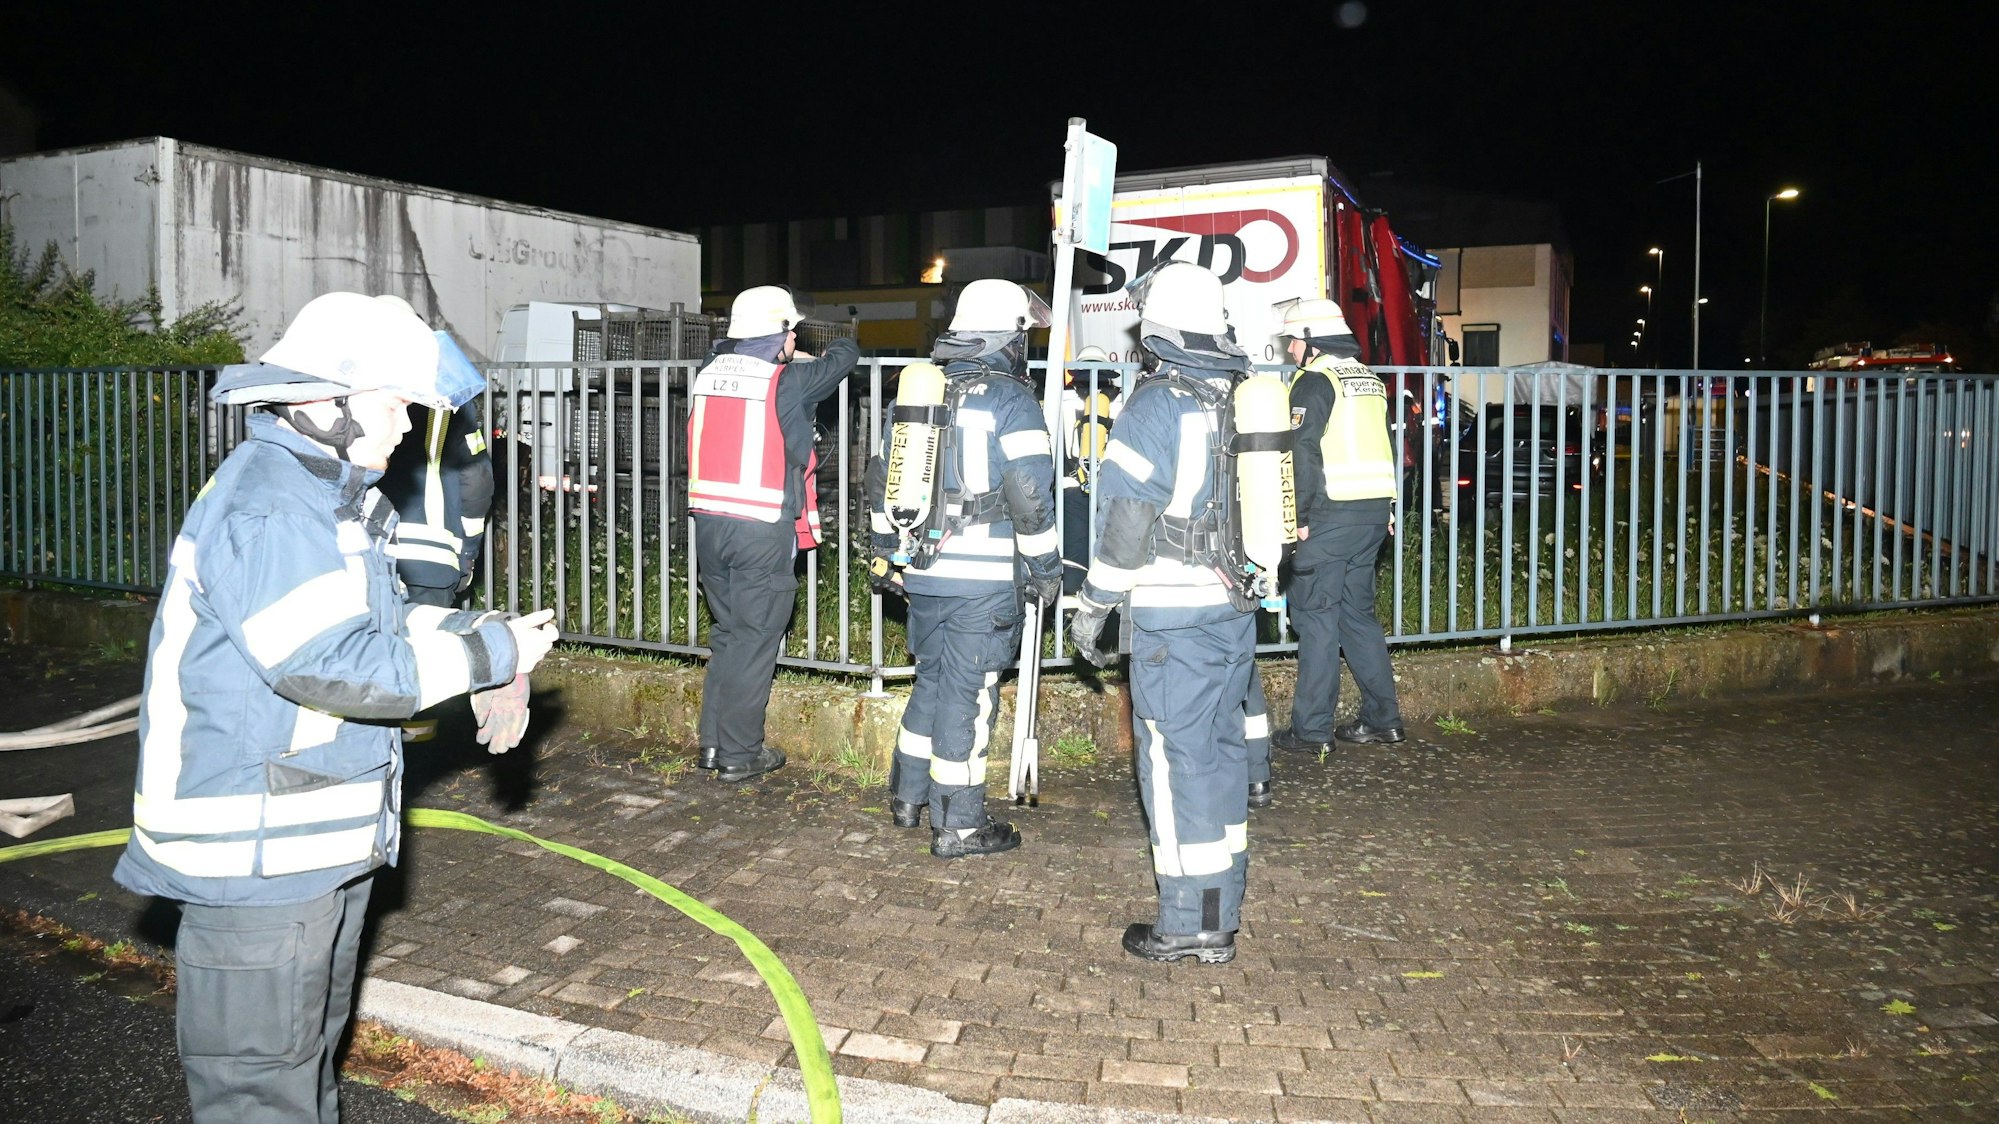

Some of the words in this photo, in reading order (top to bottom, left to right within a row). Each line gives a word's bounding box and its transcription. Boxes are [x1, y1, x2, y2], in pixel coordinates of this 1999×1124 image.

[1080, 233, 1246, 296] SKD
[713, 379, 728, 391] LZ
[731, 381, 739, 392] 9
[886, 422, 909, 501] KERPEN
[922, 436, 935, 483] Atemluft
[1280, 451, 1296, 540] KERPEN
